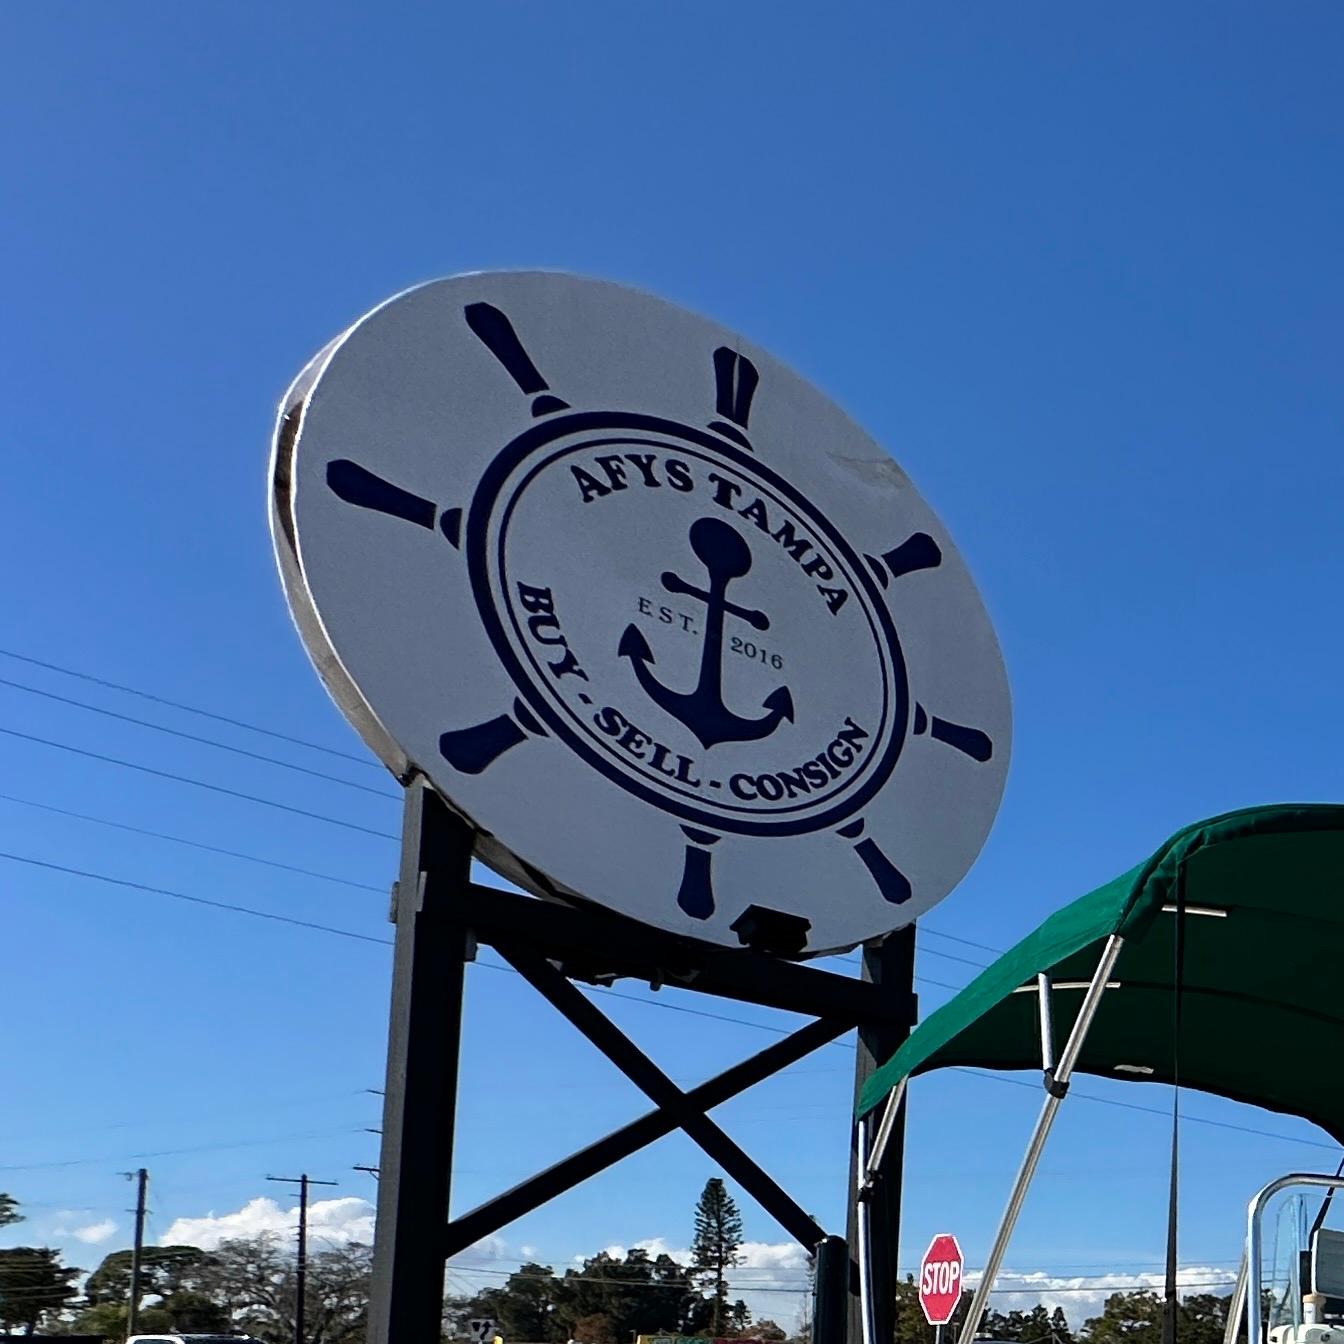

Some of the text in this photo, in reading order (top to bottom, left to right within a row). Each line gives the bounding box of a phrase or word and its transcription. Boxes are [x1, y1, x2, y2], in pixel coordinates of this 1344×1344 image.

[570, 453, 850, 616] AFYS TAMPA
[517, 582, 588, 684] BUY
[594, 706, 701, 788] SELL
[728, 717, 870, 802] CONSIGN
[638, 597, 784, 670] EST. 2016
[923, 1260, 960, 1296] STOP
